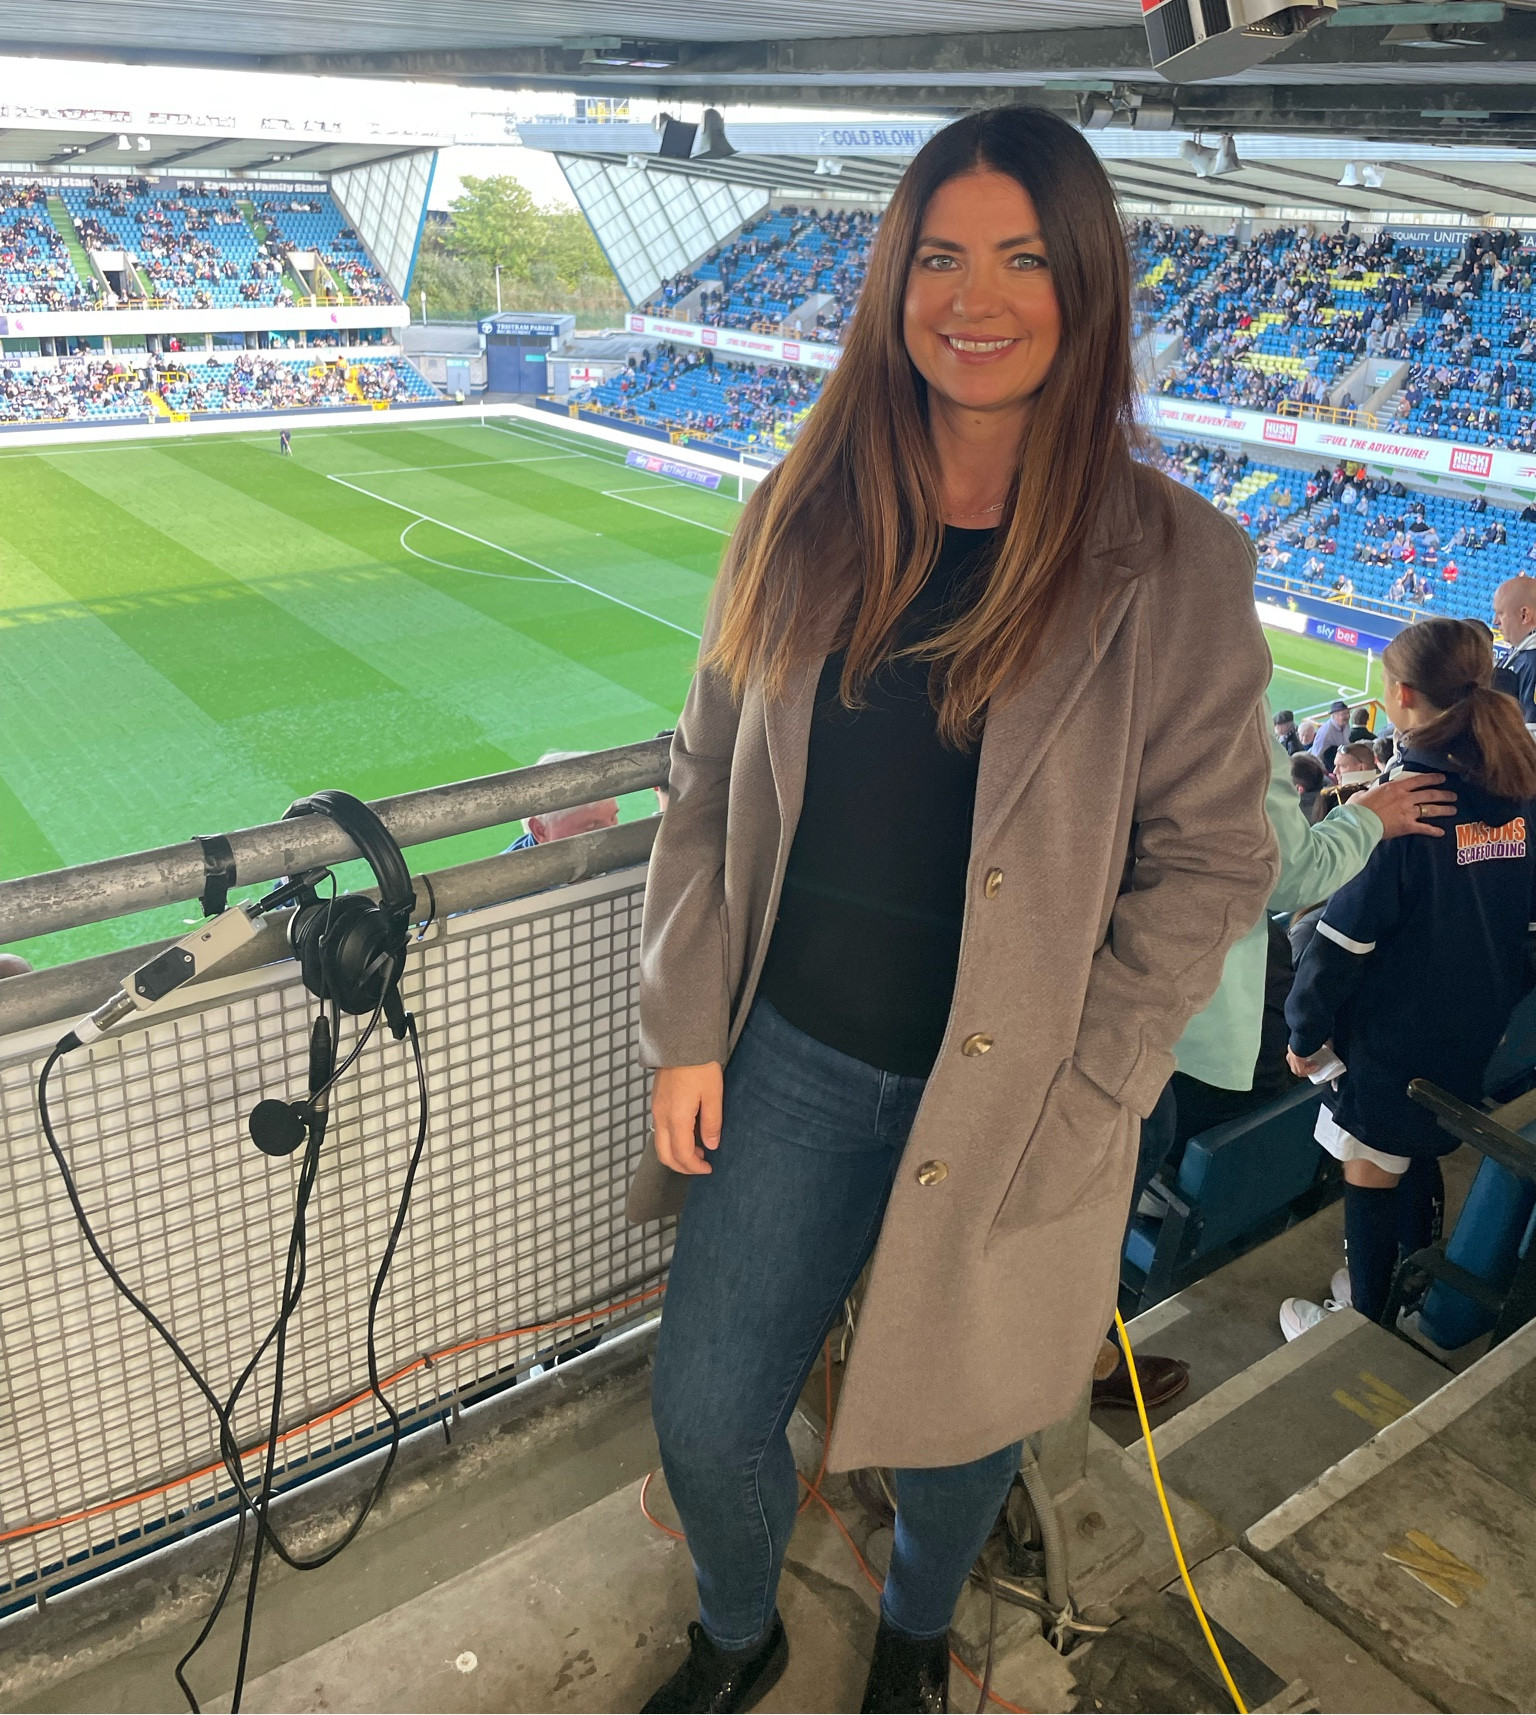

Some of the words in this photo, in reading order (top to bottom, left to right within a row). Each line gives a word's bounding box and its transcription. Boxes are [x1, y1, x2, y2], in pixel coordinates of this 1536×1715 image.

[834, 130, 869, 145] COLD
[873, 130, 914, 145] BLOW
[14, 176, 60, 187] Family
[61, 177, 92, 187] Stan
[203, 181, 254, 191] Zampa's
[255, 182, 294, 192] Family
[295, 183, 327, 192] Stand
[1393, 231, 1430, 241] EQUALITY
[1434, 231, 1472, 244] UNITE
[1181, 412, 1196, 422] THE
[1196, 414, 1246, 430] ADVENTURE!
[1266, 421, 1294, 435] HUSKI
[1322, 434, 1348, 446] FUEL
[1350, 438, 1367, 450] THE
[1367, 442, 1429, 460] ADVENTURE!
[1453, 451, 1489, 467] HUSKI
[662, 462, 686, 477] BETTING
[686, 471, 708, 483] BETTER
[1452, 463, 1487, 474] CHOCOLATE
[1316, 624, 1334, 638] sky
[1337, 629, 1355, 643] bet
[1456, 817, 1526, 849] MASONS
[1457, 841, 1526, 865] SCAFFOLDING
